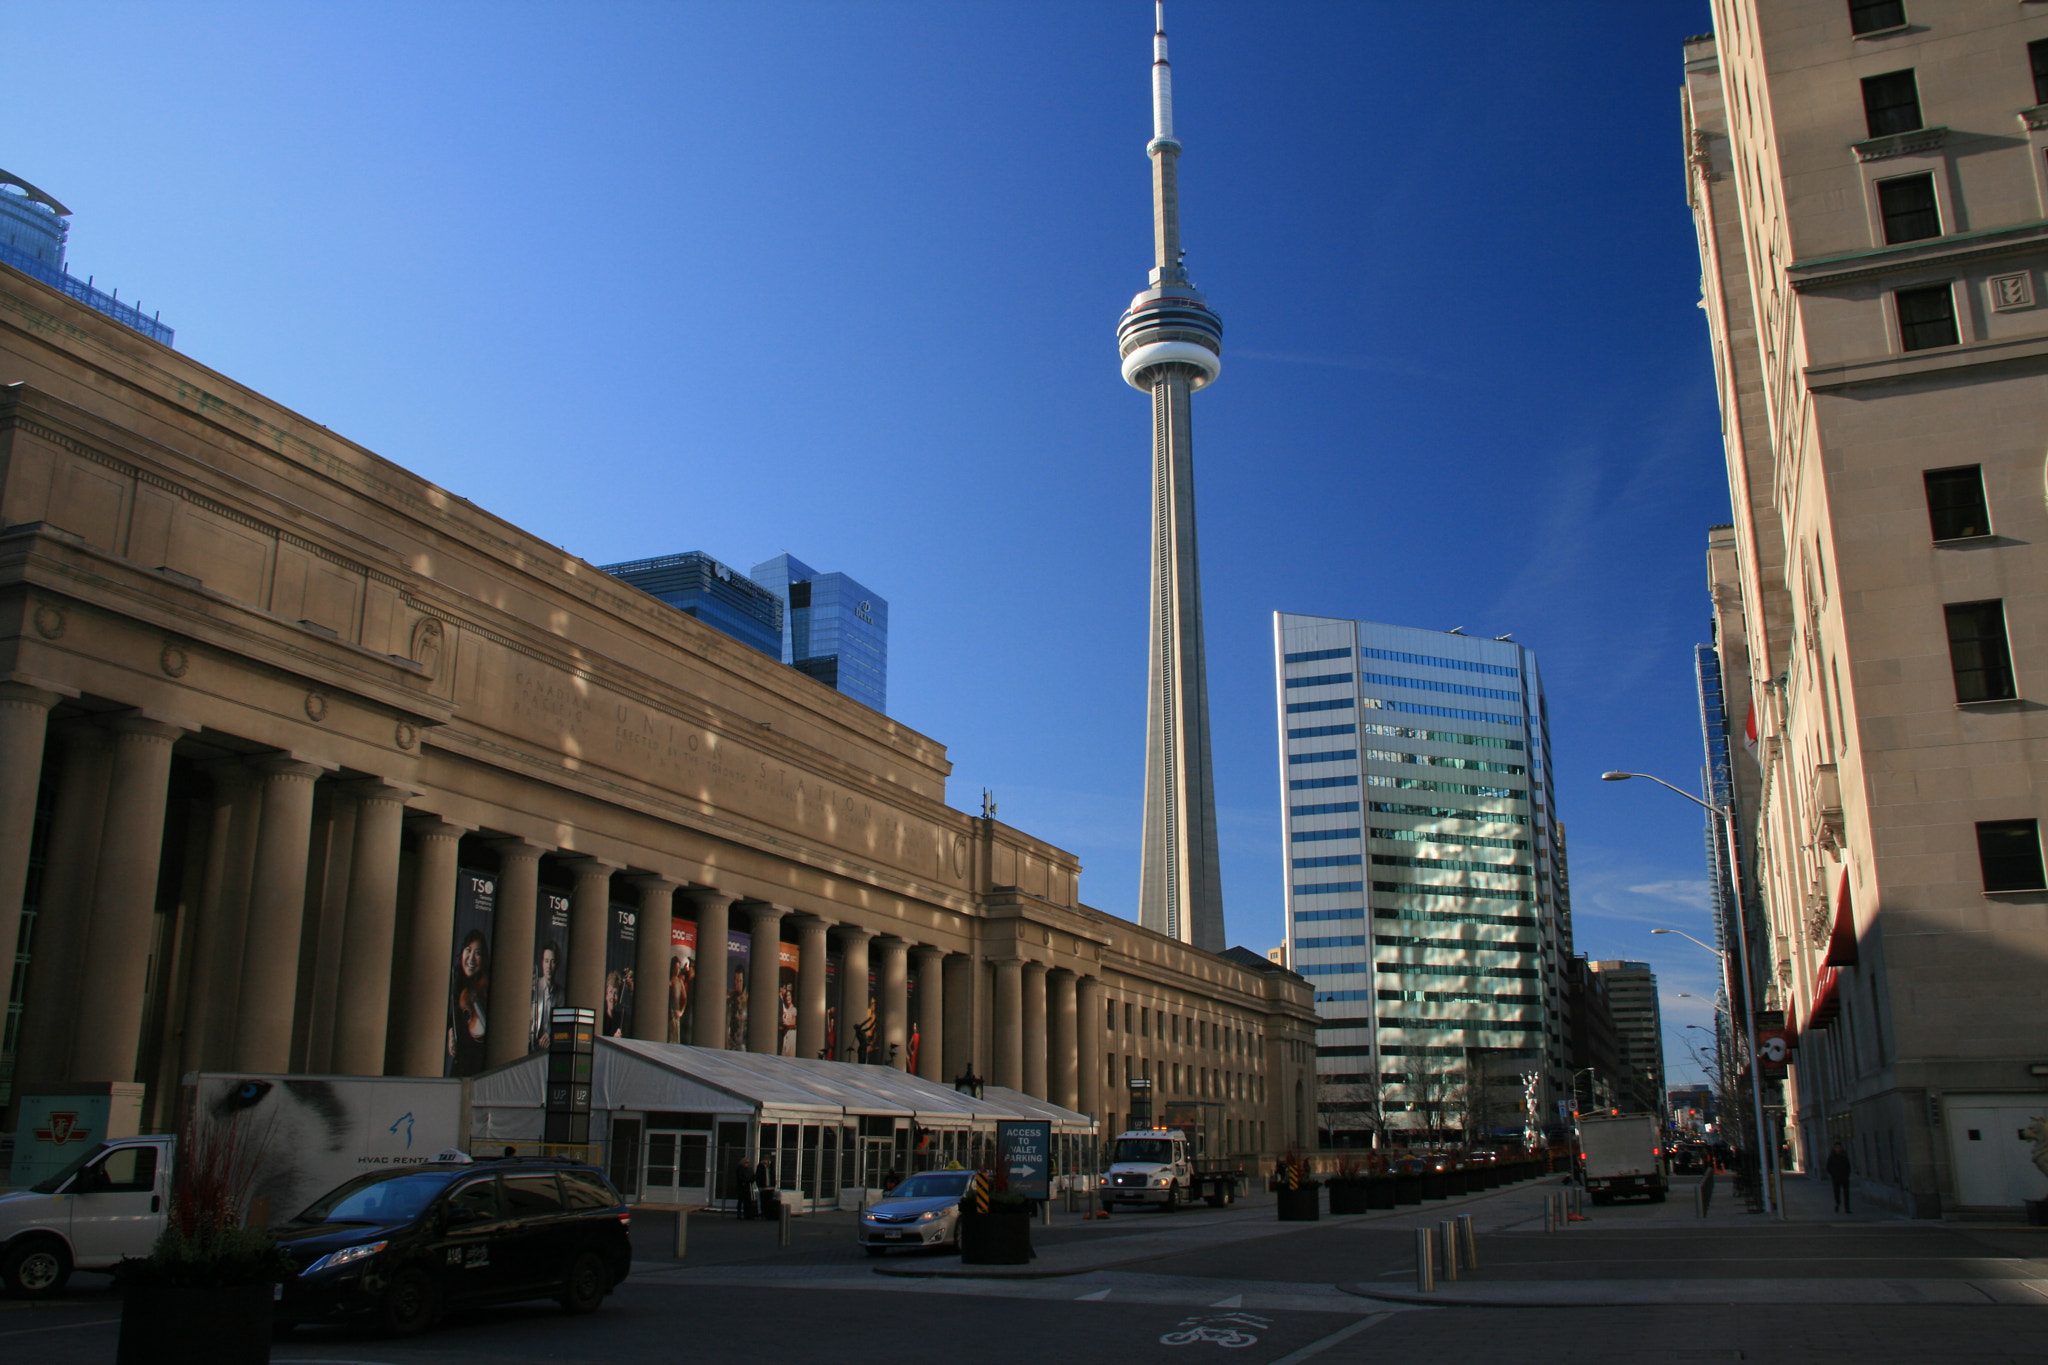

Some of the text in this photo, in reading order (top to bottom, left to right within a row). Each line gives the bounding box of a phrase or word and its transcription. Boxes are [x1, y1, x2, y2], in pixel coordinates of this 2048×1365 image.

[855, 607, 874, 626] DELTA
[616, 703, 723, 762] UNION
[759, 762, 872, 819] STATION
[471, 877, 494, 895] TSO
[548, 895, 569, 912] TSO
[617, 911, 636, 926] TSO
[1006, 1128, 1042, 1137] ACCESS
[1018, 1137, 1030, 1146] TO
[1011, 1145, 1038, 1154] VALET
[358, 1156, 389, 1164] HVAC
[438, 1153, 457, 1161] TAXI
[1004, 1153, 1043, 1163] PARKING
